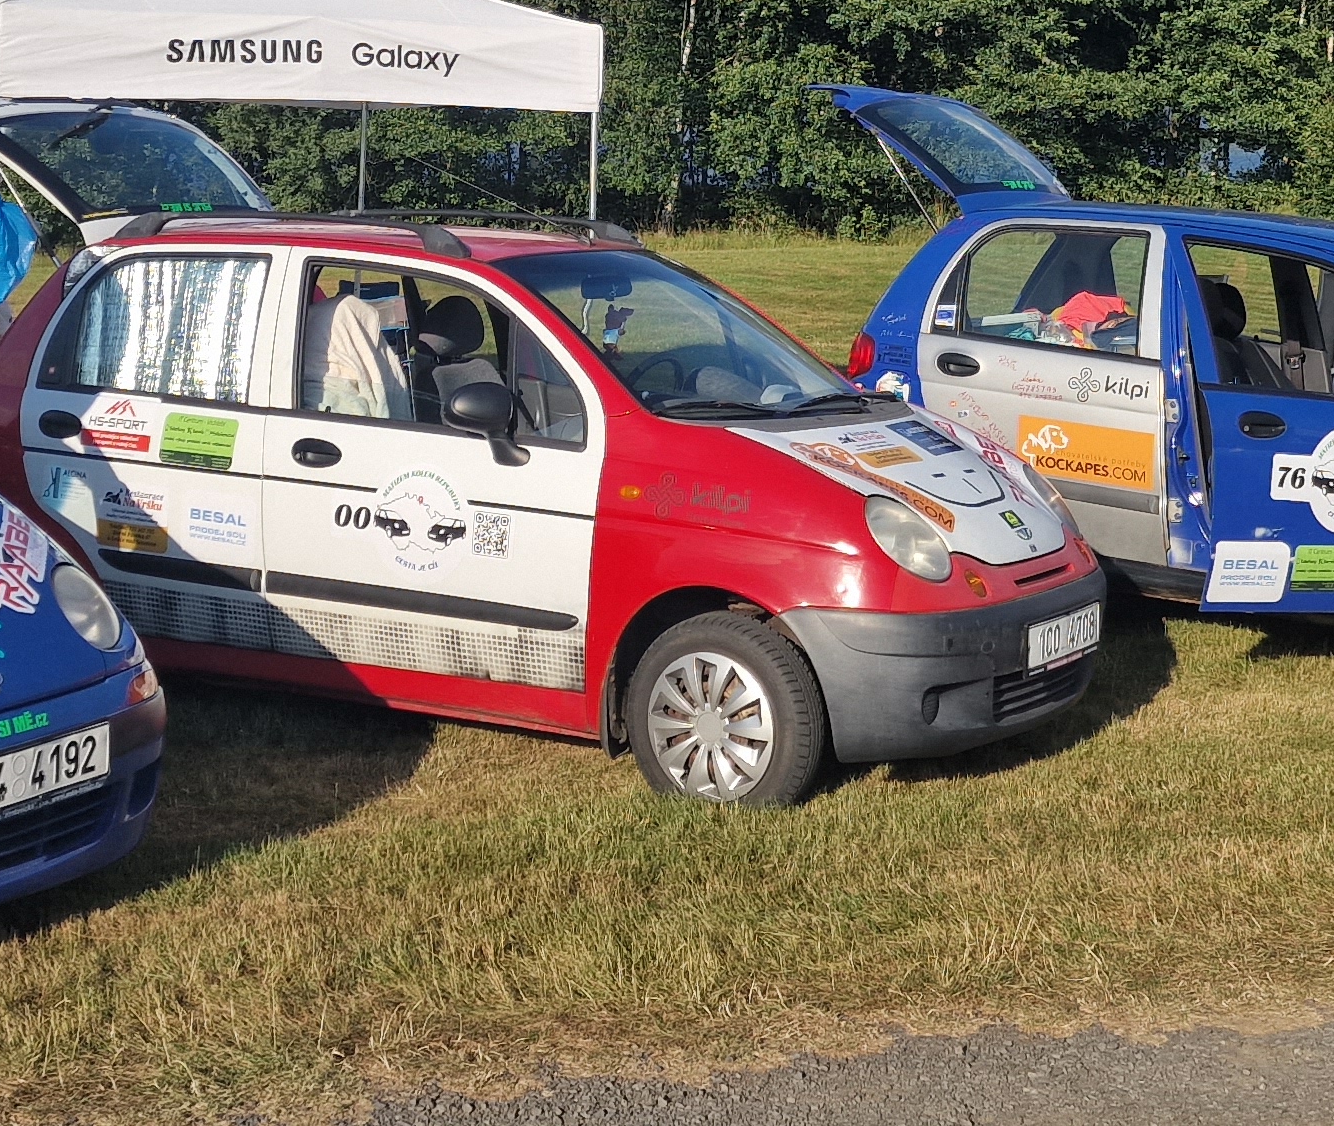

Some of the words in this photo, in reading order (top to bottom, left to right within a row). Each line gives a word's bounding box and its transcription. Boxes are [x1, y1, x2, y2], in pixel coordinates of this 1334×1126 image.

[166, 38, 323, 64] SAMSUNG
[351, 42, 460, 77] Galaxy
[1104, 374, 1150, 400] kilpi
[88, 415, 148, 431] HS-SPORT
[1035, 455, 1147, 483] KOCKAPES.COM
[1277, 466, 1307, 489] 76
[690, 482, 752, 516] kilpi
[189, 508, 247, 527] BESAL
[334, 503, 371, 530] 00
[189, 525, 225, 537] PRODEJ
[1222, 559, 1279, 570] BESAL
[30, 734, 97, 791] 4192
